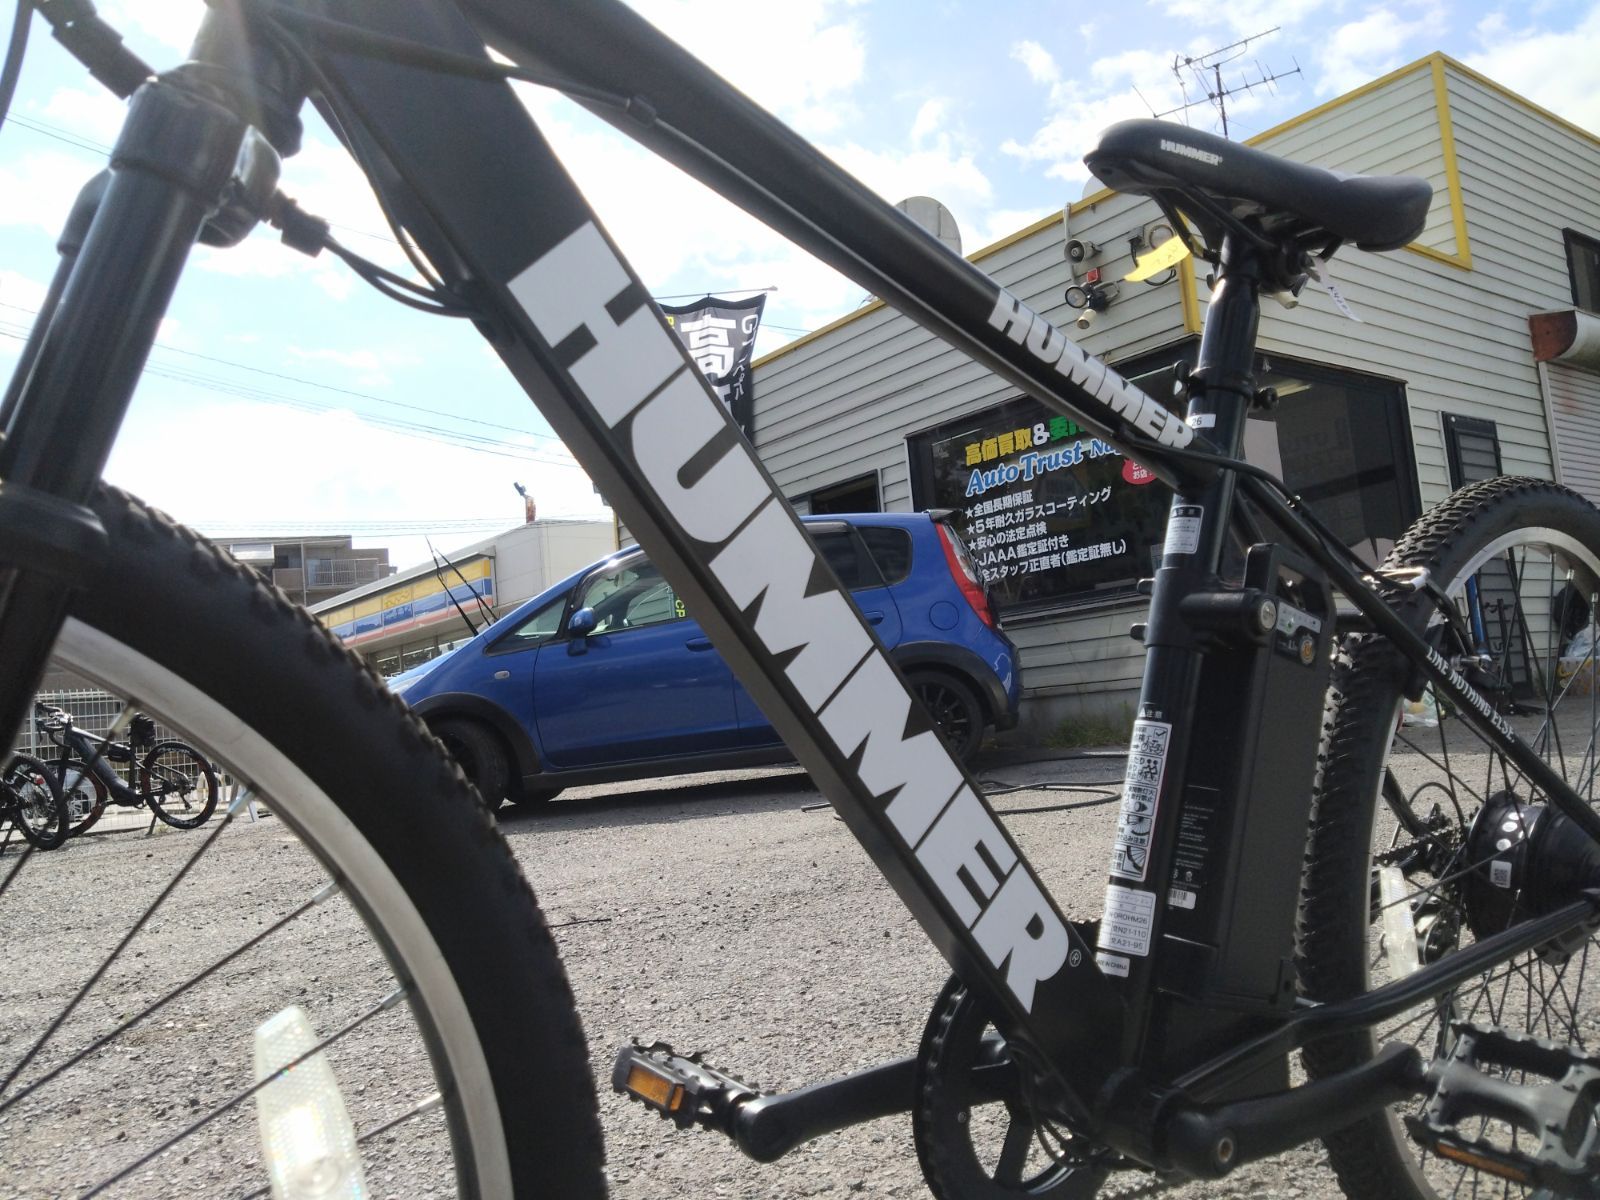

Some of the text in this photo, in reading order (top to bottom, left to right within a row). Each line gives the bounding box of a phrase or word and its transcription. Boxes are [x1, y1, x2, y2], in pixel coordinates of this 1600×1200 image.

[1160, 138, 1219, 166] HUMMER
[987, 288, 1194, 449] HUMMER
[965, 463, 1019, 498] Auto
[1019, 440, 1083, 482] Trust
[507, 220, 1069, 1014] HUMMER
[1425, 646, 1449, 675] LIKE
[1448, 670, 1492, 718] NOTHING
